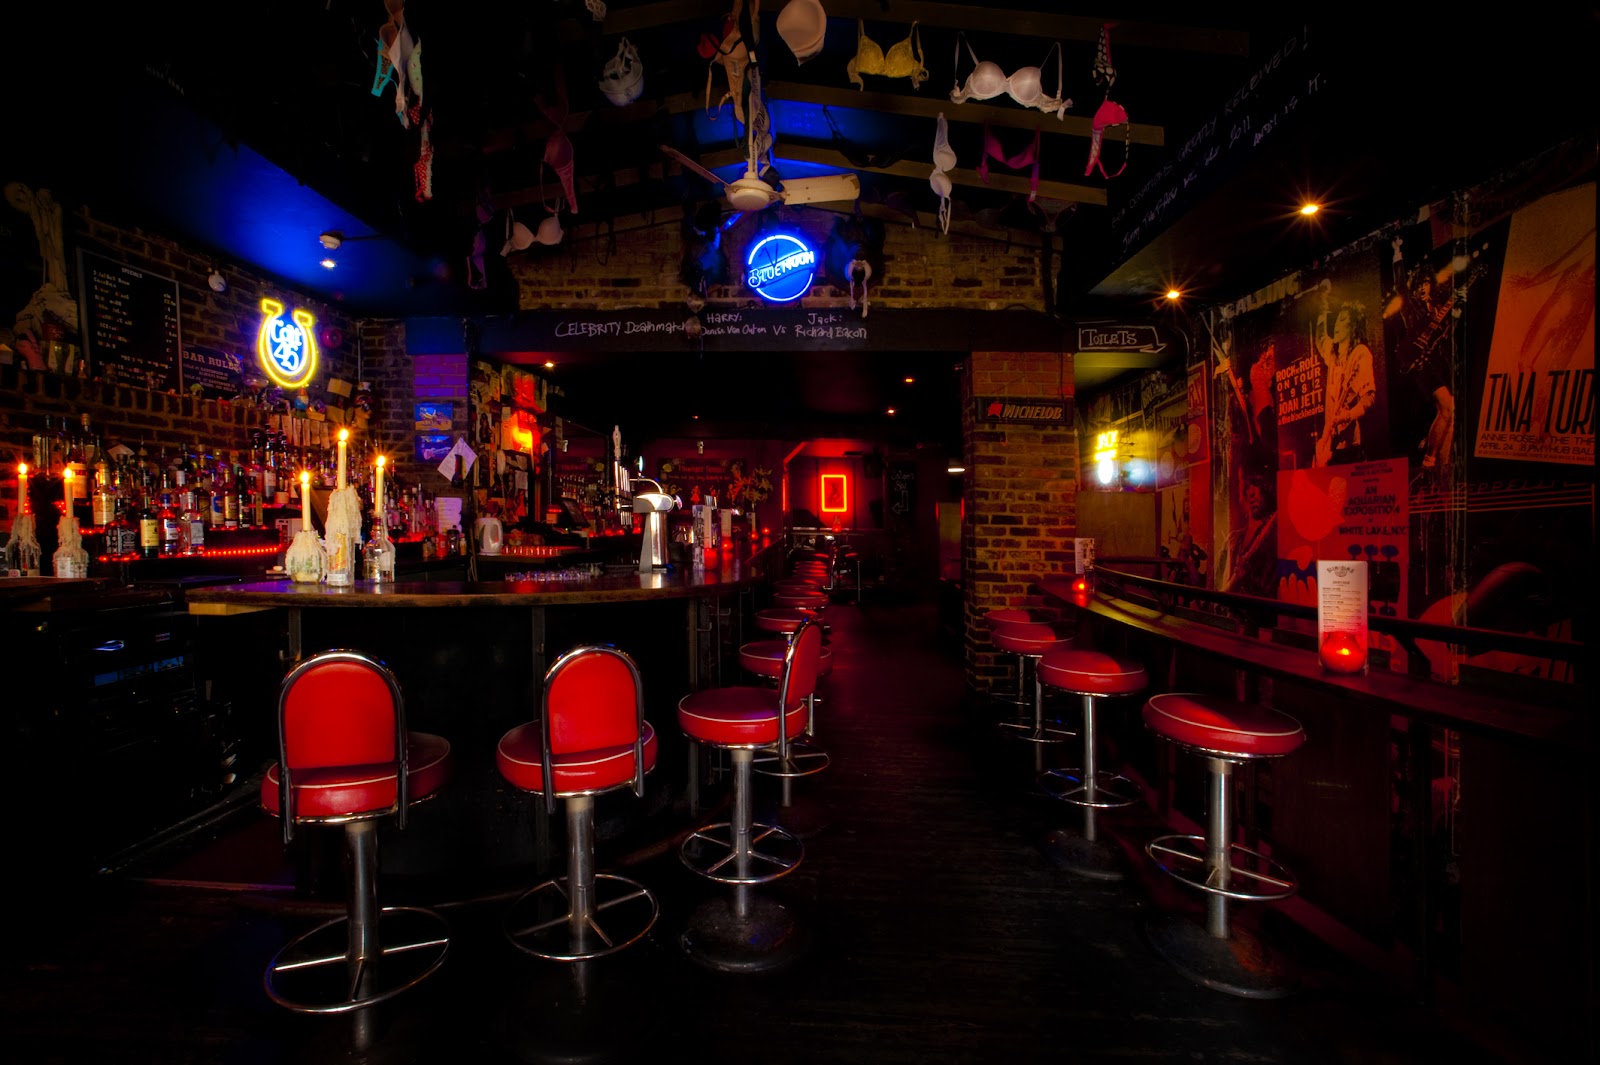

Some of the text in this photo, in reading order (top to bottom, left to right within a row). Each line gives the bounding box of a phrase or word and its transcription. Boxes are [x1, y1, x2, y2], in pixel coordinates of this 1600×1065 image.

[554, 321, 622, 338] CELEBRITY
[835, 326, 868, 340] Bacon
[182, 350, 206, 364] BAR
[1276, 366, 1321, 392] ON TOUR
[1278, 388, 1323, 417] JOAN JETT
[1484, 372, 1537, 433] TINA
[1001, 403, 1063, 420] MICHELOB
[1365, 485, 1377, 496] AN
[1348, 493, 1396, 506] AQUARIAN
[1337, 525, 1364, 536] WHITE
